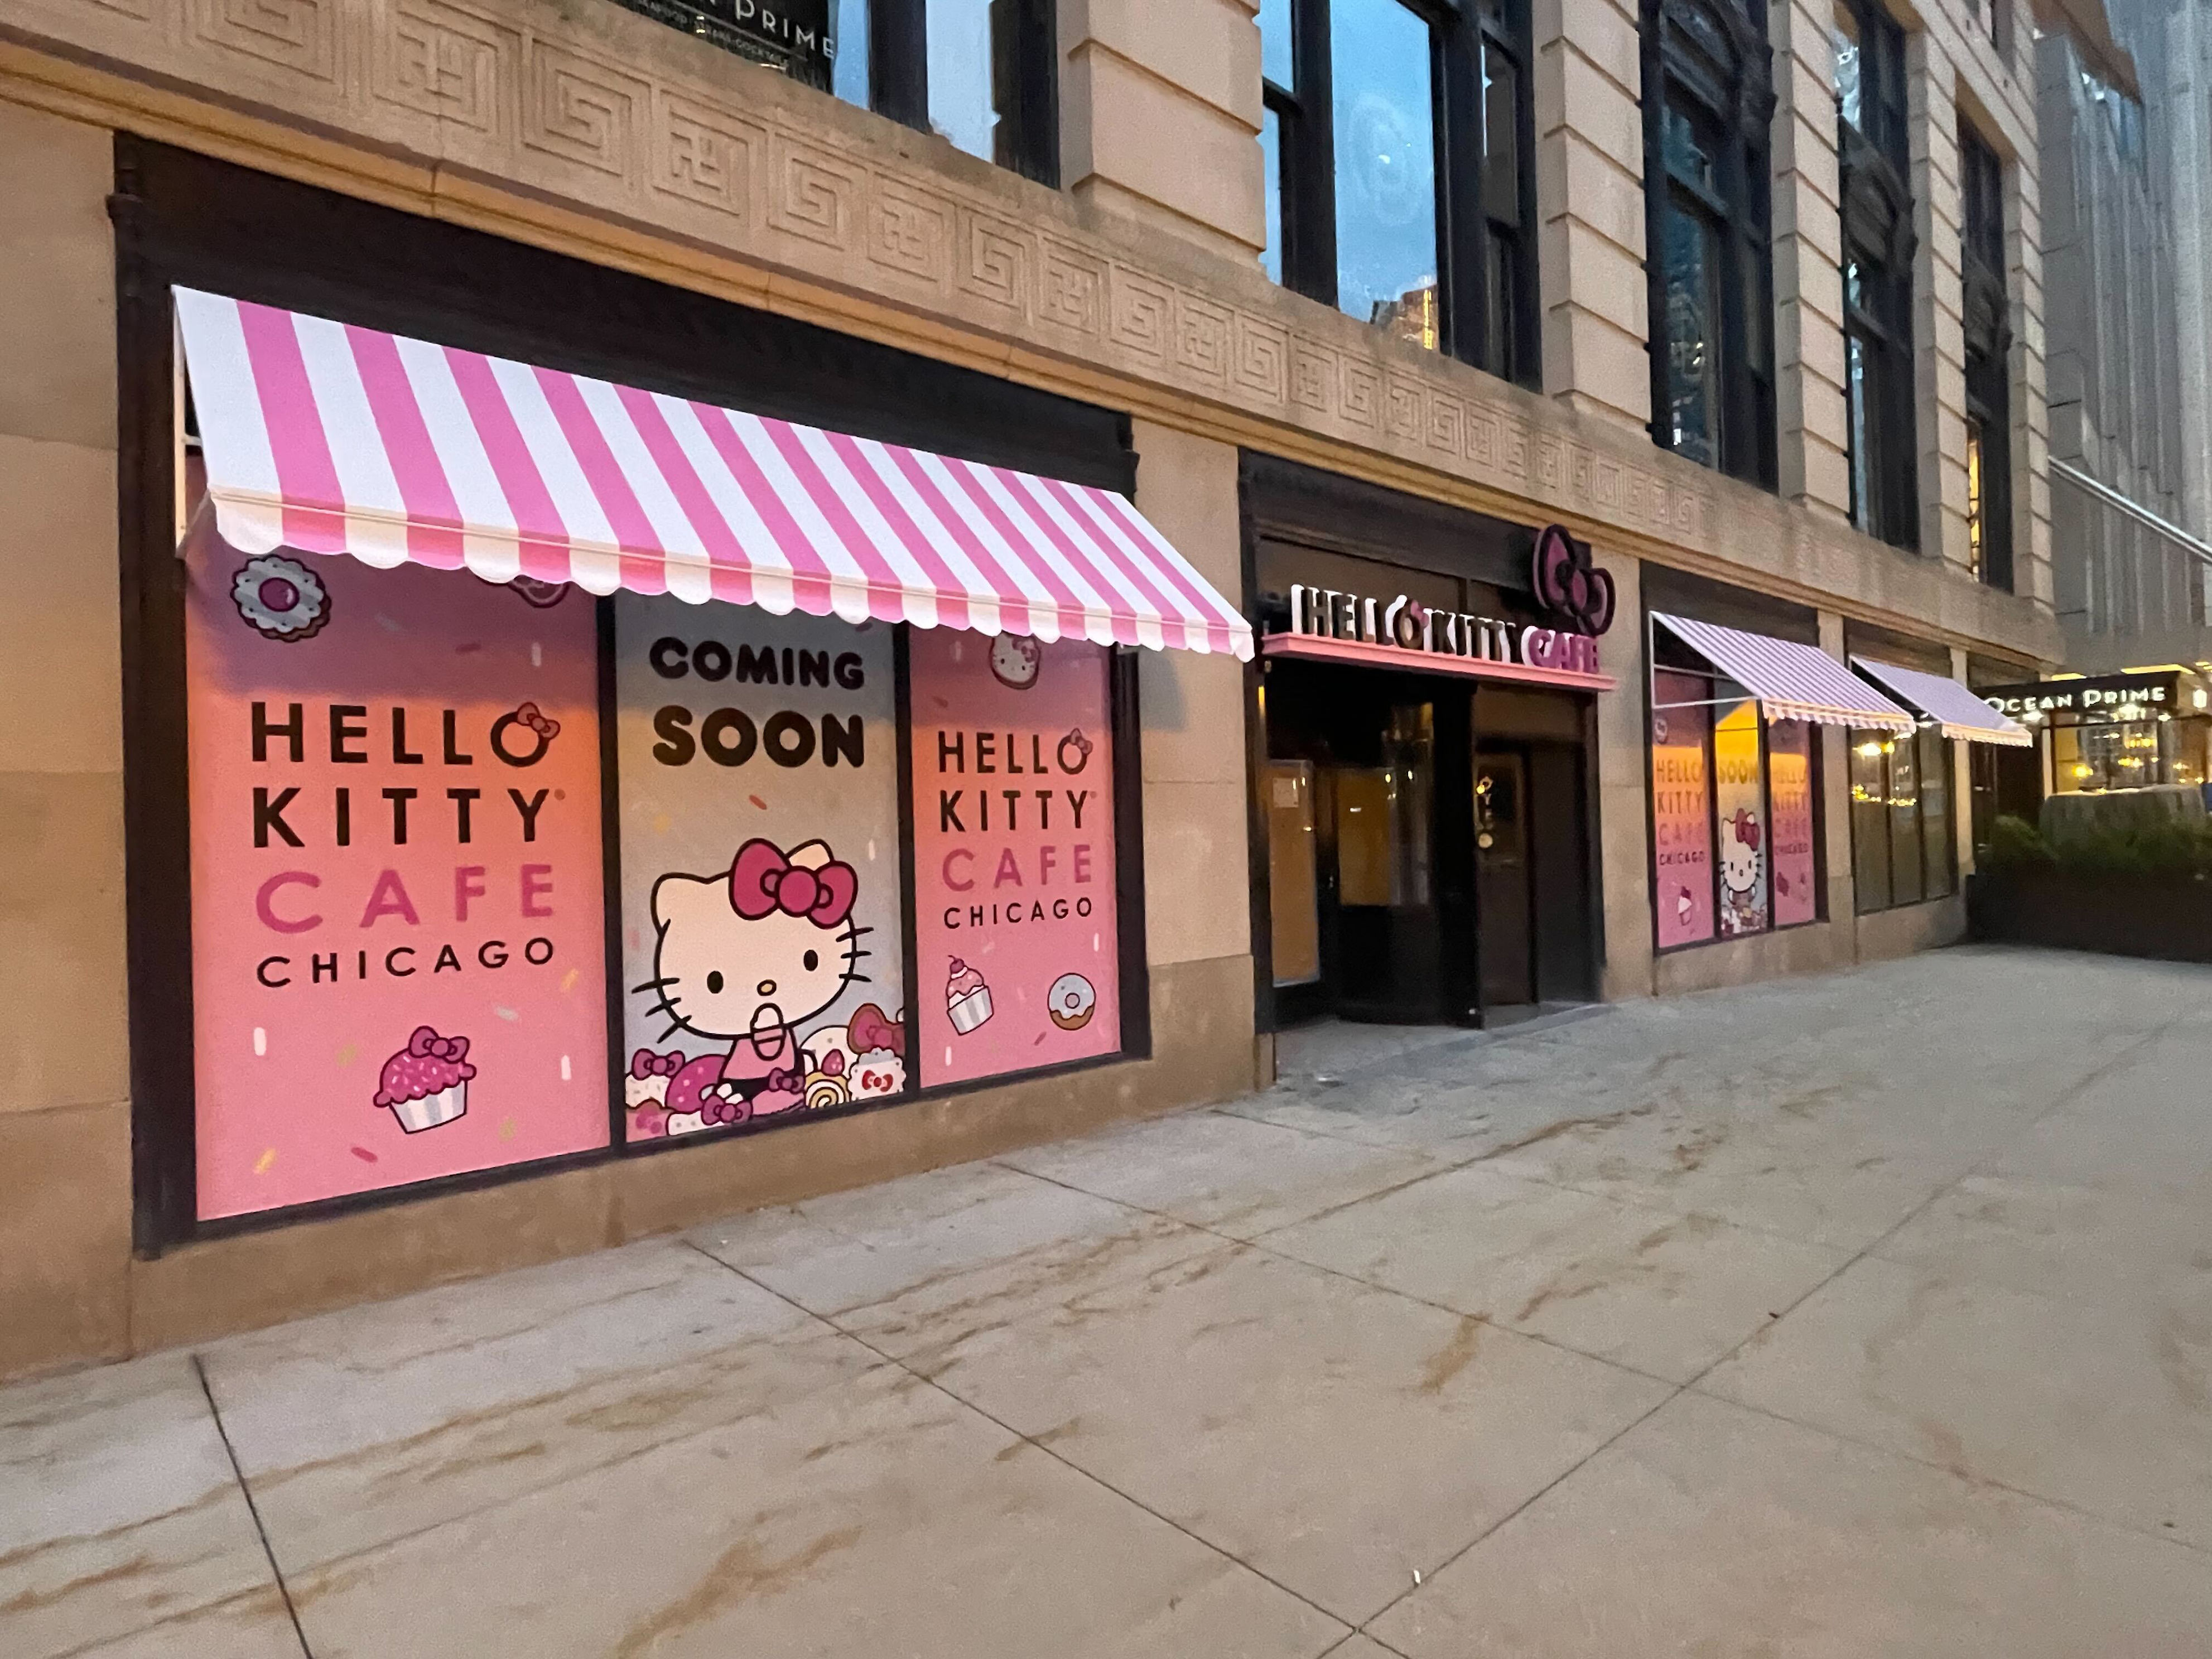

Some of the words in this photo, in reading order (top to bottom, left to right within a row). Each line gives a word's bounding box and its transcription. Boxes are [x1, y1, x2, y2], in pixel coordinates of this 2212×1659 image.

[735, 0, 834, 59] PRIME
[1291, 584, 1428, 649] HELLO
[1423, 607, 1524, 663] KITTY
[1521, 625, 1599, 674] CAFE
[649, 636, 865, 690] COMING
[1983, 693, 2072, 713] OCEAN
[2083, 686, 2166, 708] PRIME
[251, 701, 561, 768] HELLO
[652, 705, 865, 768] SOON
[937, 728, 1093, 775] HELLO
[1656, 759, 1704, 783] HELLO
[252, 787, 550, 848] KITTY
[940, 789, 1088, 833] KITTY
[1657, 791, 1703, 814] KITTY
[942, 844, 1092, 892] CAFE
[255, 864, 555, 934] CAFE
[944, 896, 1092, 929] CHICAGO
[256, 937, 555, 988] CHICAGO
